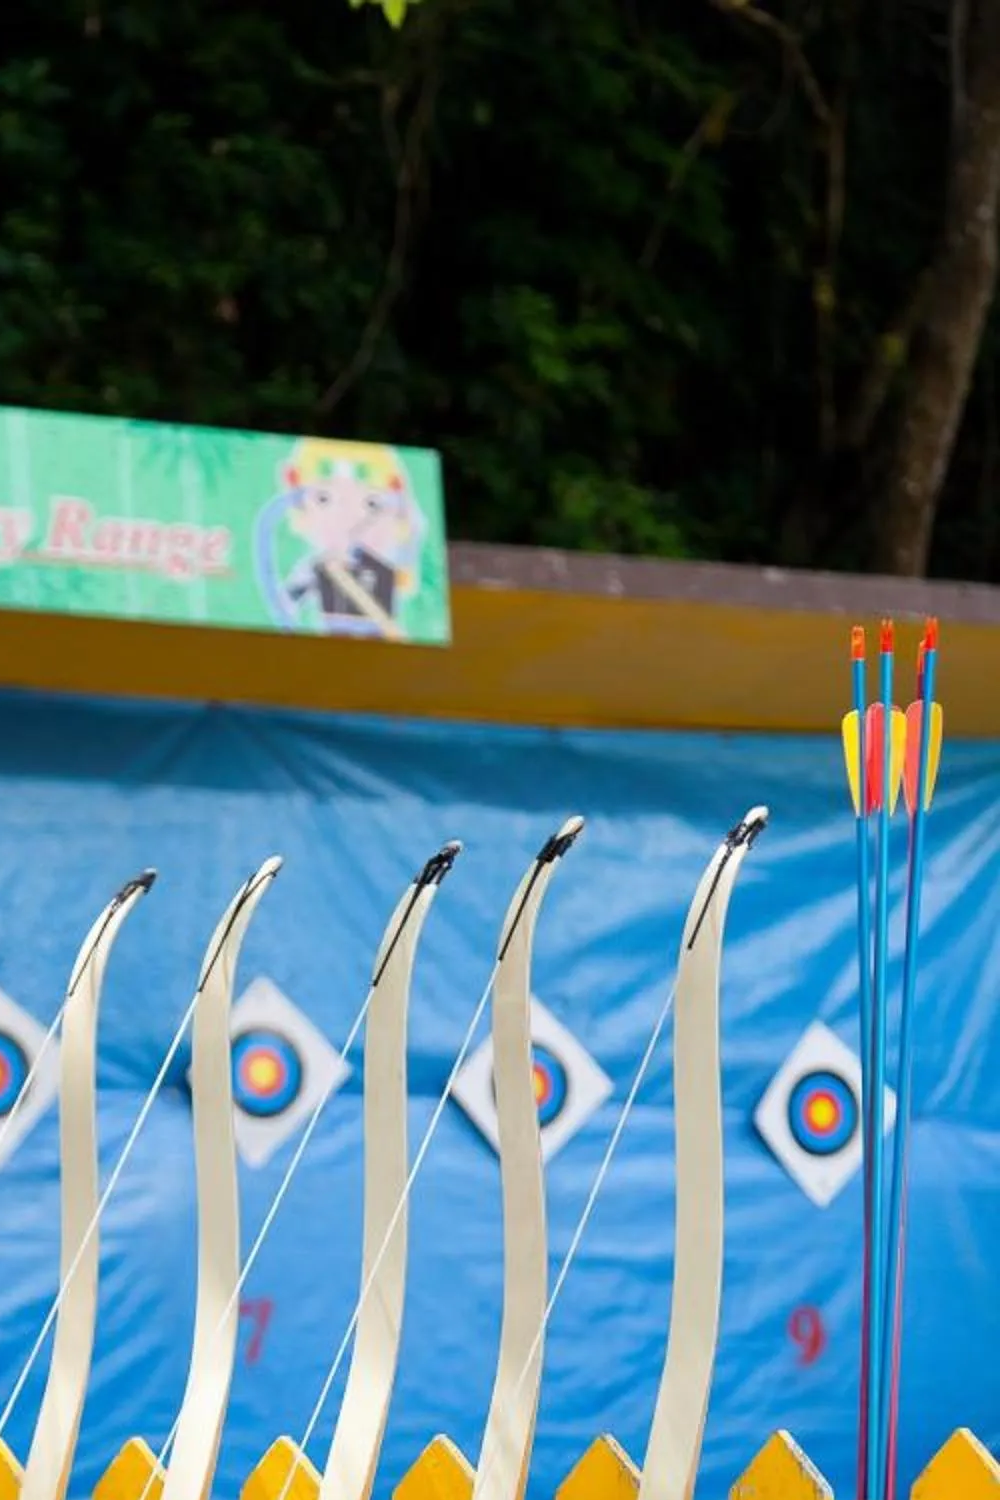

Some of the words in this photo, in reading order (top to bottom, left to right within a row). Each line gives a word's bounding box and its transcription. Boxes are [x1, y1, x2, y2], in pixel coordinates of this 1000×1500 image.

[40, 495, 232, 579] Range
[238, 1297, 274, 1366] 7
[788, 1305, 827, 1367] 9
